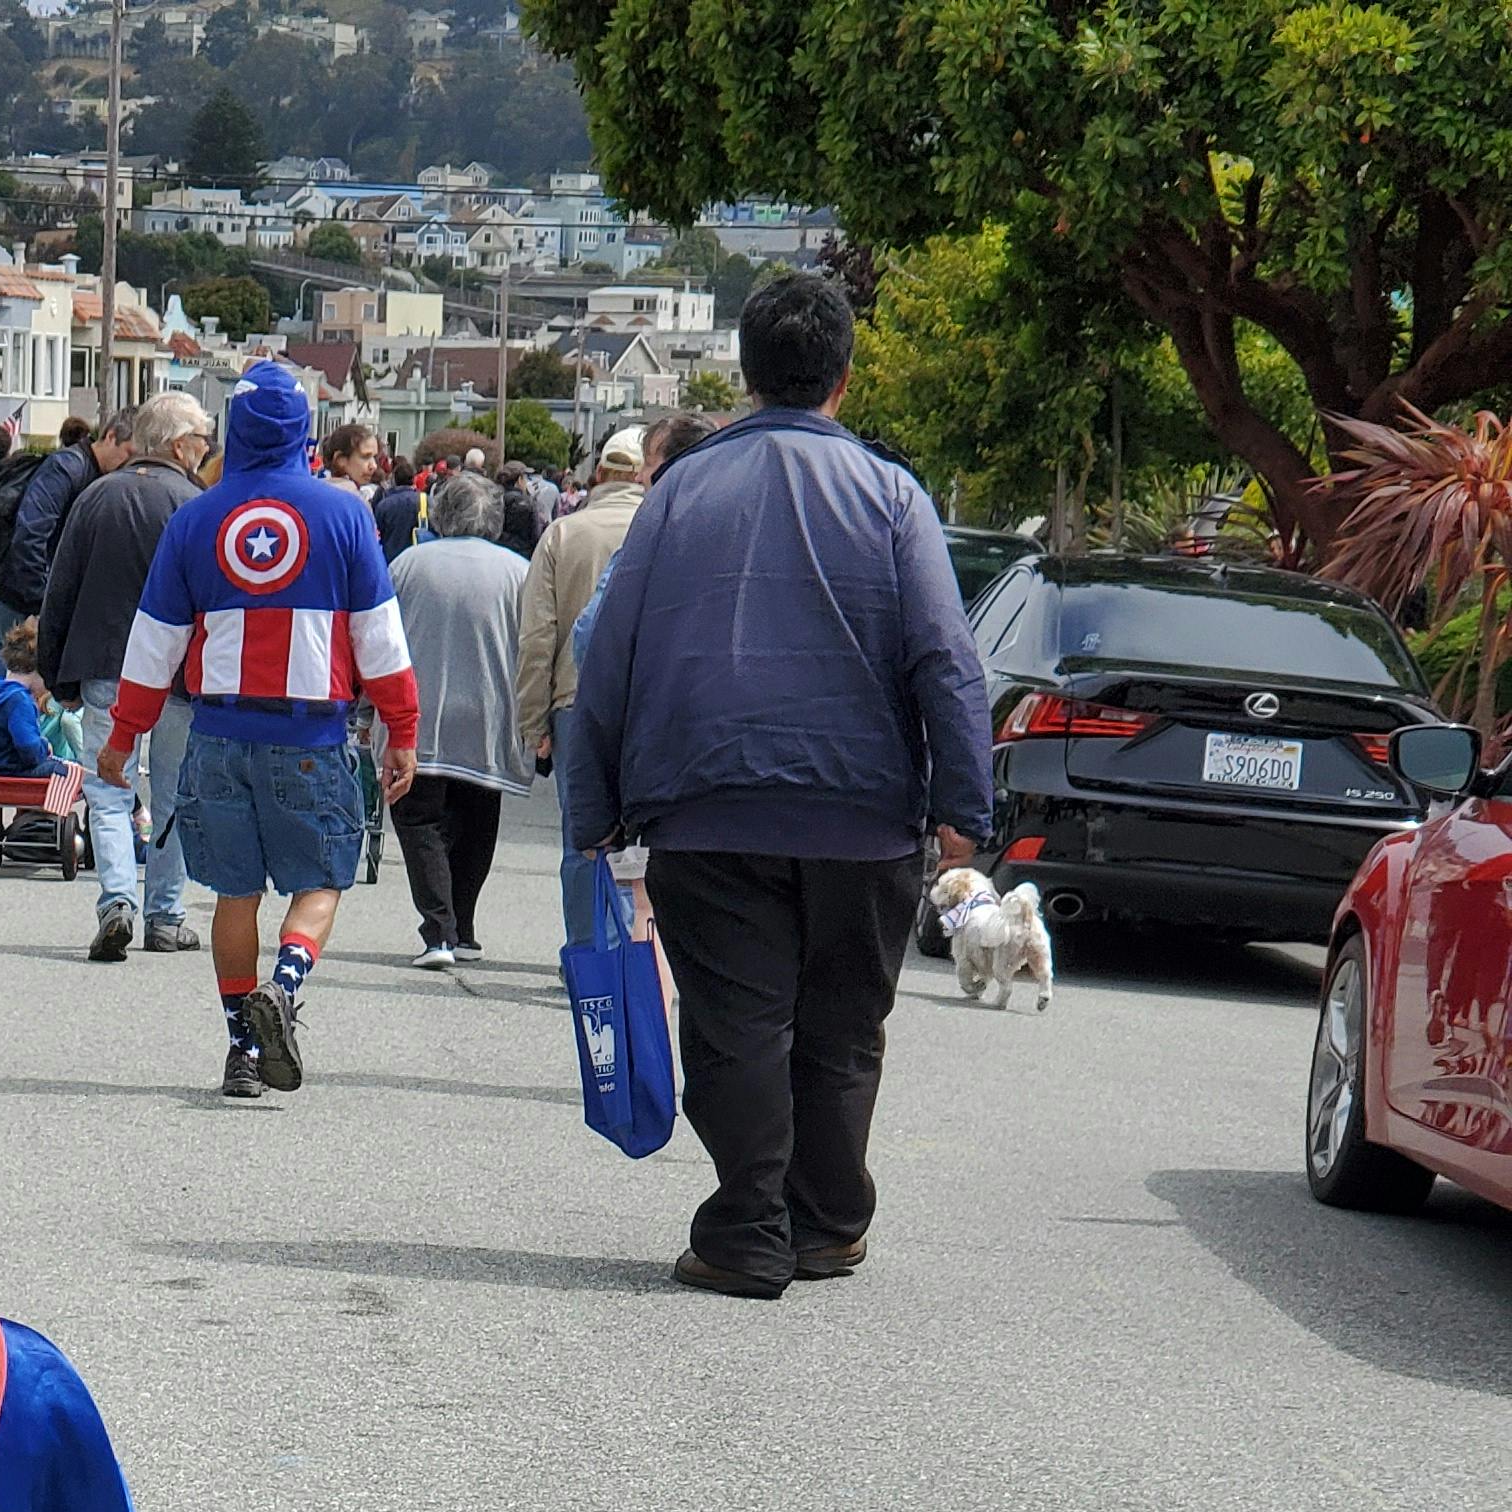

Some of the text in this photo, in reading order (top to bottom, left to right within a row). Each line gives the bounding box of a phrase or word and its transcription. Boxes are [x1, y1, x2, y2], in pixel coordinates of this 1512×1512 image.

[182, 359, 230, 368] SAN JUAN
[1346, 788, 1395, 801] IS 250
